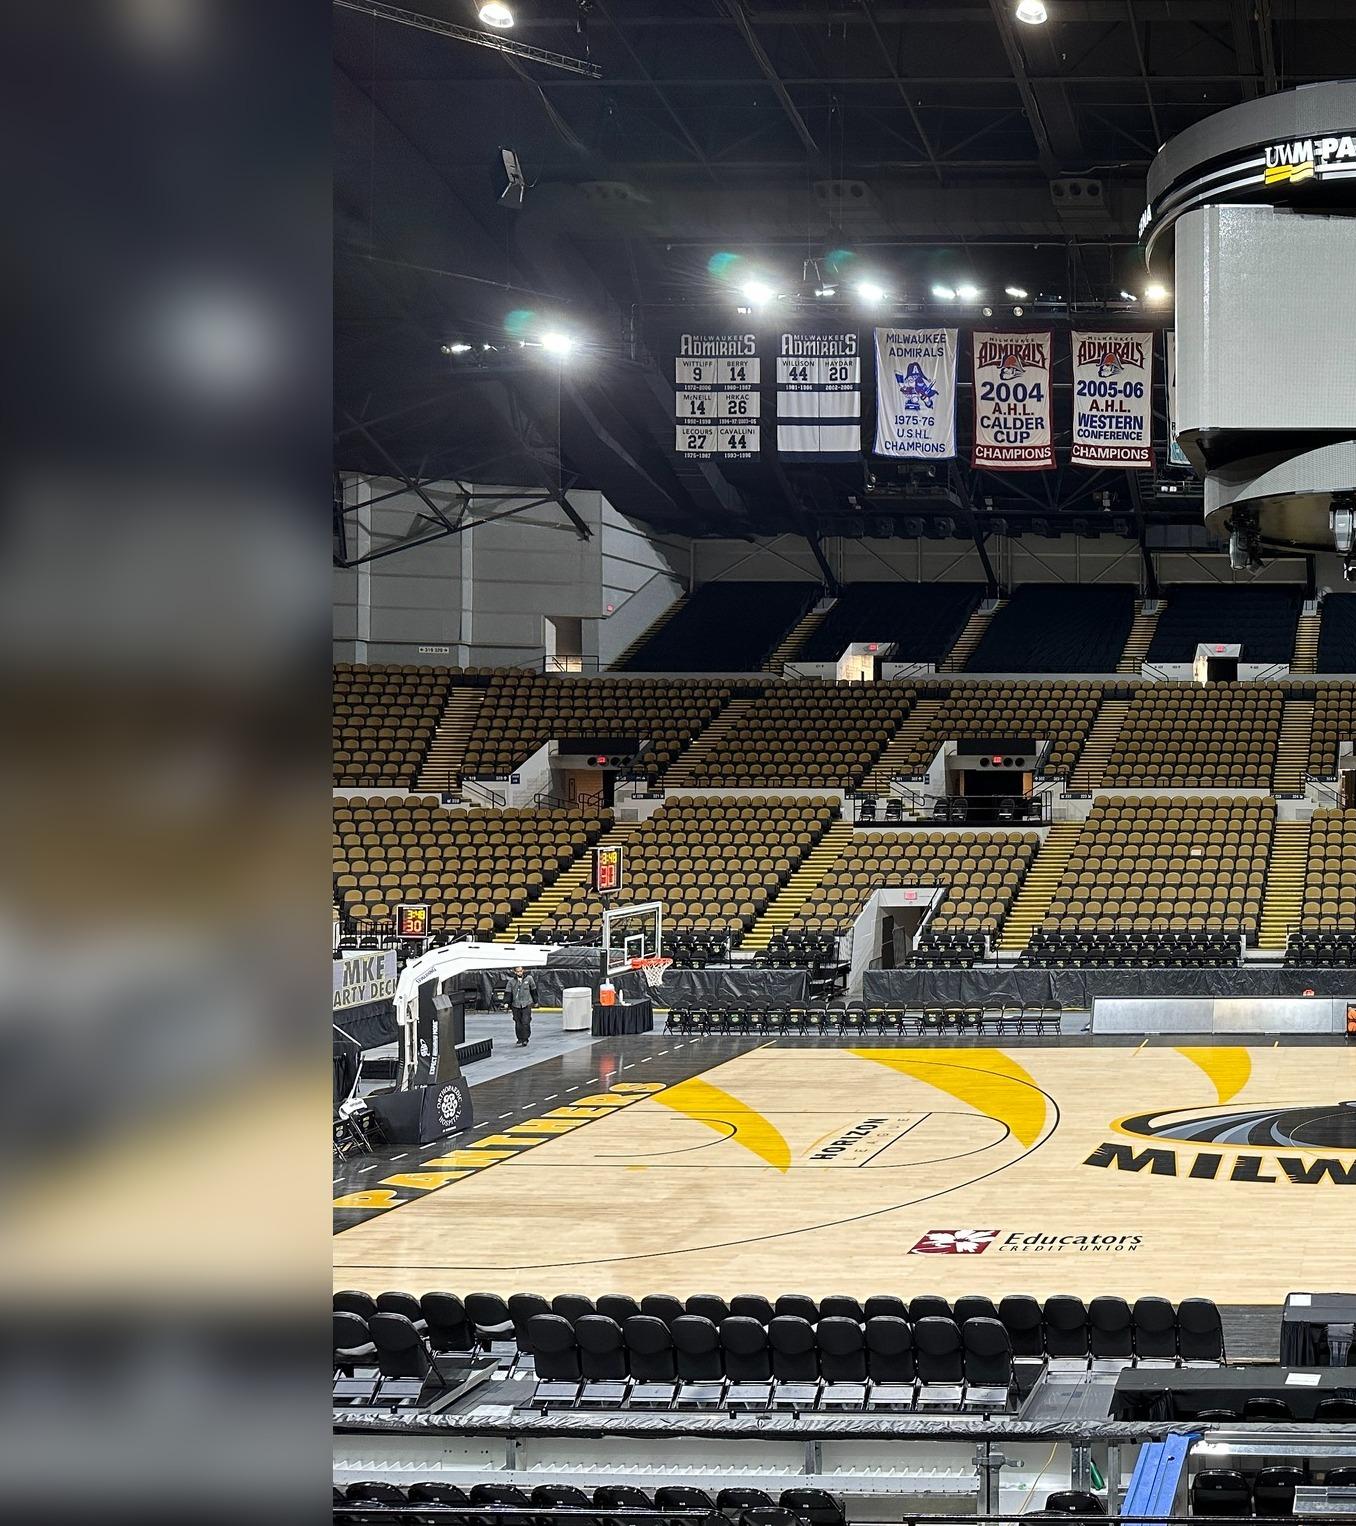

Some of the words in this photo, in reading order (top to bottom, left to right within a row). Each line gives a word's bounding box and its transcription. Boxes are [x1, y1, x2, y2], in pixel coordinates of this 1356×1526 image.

[1264, 139, 1314, 167] UWM
[681, 334, 755, 355] ADMIRALS
[782, 334, 856, 355] ADMIRALS
[887, 334, 946, 343] MILWAUKEE
[889, 348, 944, 357] ADMIRALS
[978, 341, 1046, 370] ADMIRALS
[1077, 341, 1145, 370] ADMIRALS
[693, 368, 702, 381] 9
[730, 367, 746, 381] 14
[789, 367, 808, 381] 44
[829, 367, 848, 381] 20
[980, 382, 1044, 403] 2004
[1077, 380, 1144, 398] 2005-06
[690, 401, 705, 415] 14
[728, 401, 747, 415] 26
[992, 403, 1034, 416] A.H.L.
[1089, 399, 1131, 413] A.H.L.
[895, 416, 935, 426] 1975-76
[980, 416, 1045, 430] CALDER
[1078, 412, 1143, 431] WESTERN
[688, 435, 706, 449] 27
[728, 435, 746, 449] 44
[994, 431, 1030, 444] CUP
[1077, 429, 1143, 441] CONFERENCE
[885, 441, 945, 452] CHAMPIONS
[975, 446, 1051, 460] CHAMPIONS
[1073, 445, 1149, 460] CHAMPIONS
[601, 865, 614, 886] 30
[407, 921, 421, 932] 30
[343, 955, 385, 987] MKE
[333, 985, 365, 1007] ARTY
[333, 1082, 667, 1209] PANTHERS
[809, 1118, 889, 1160] HORIZON
[1004, 1232, 1143, 1245] Educators
